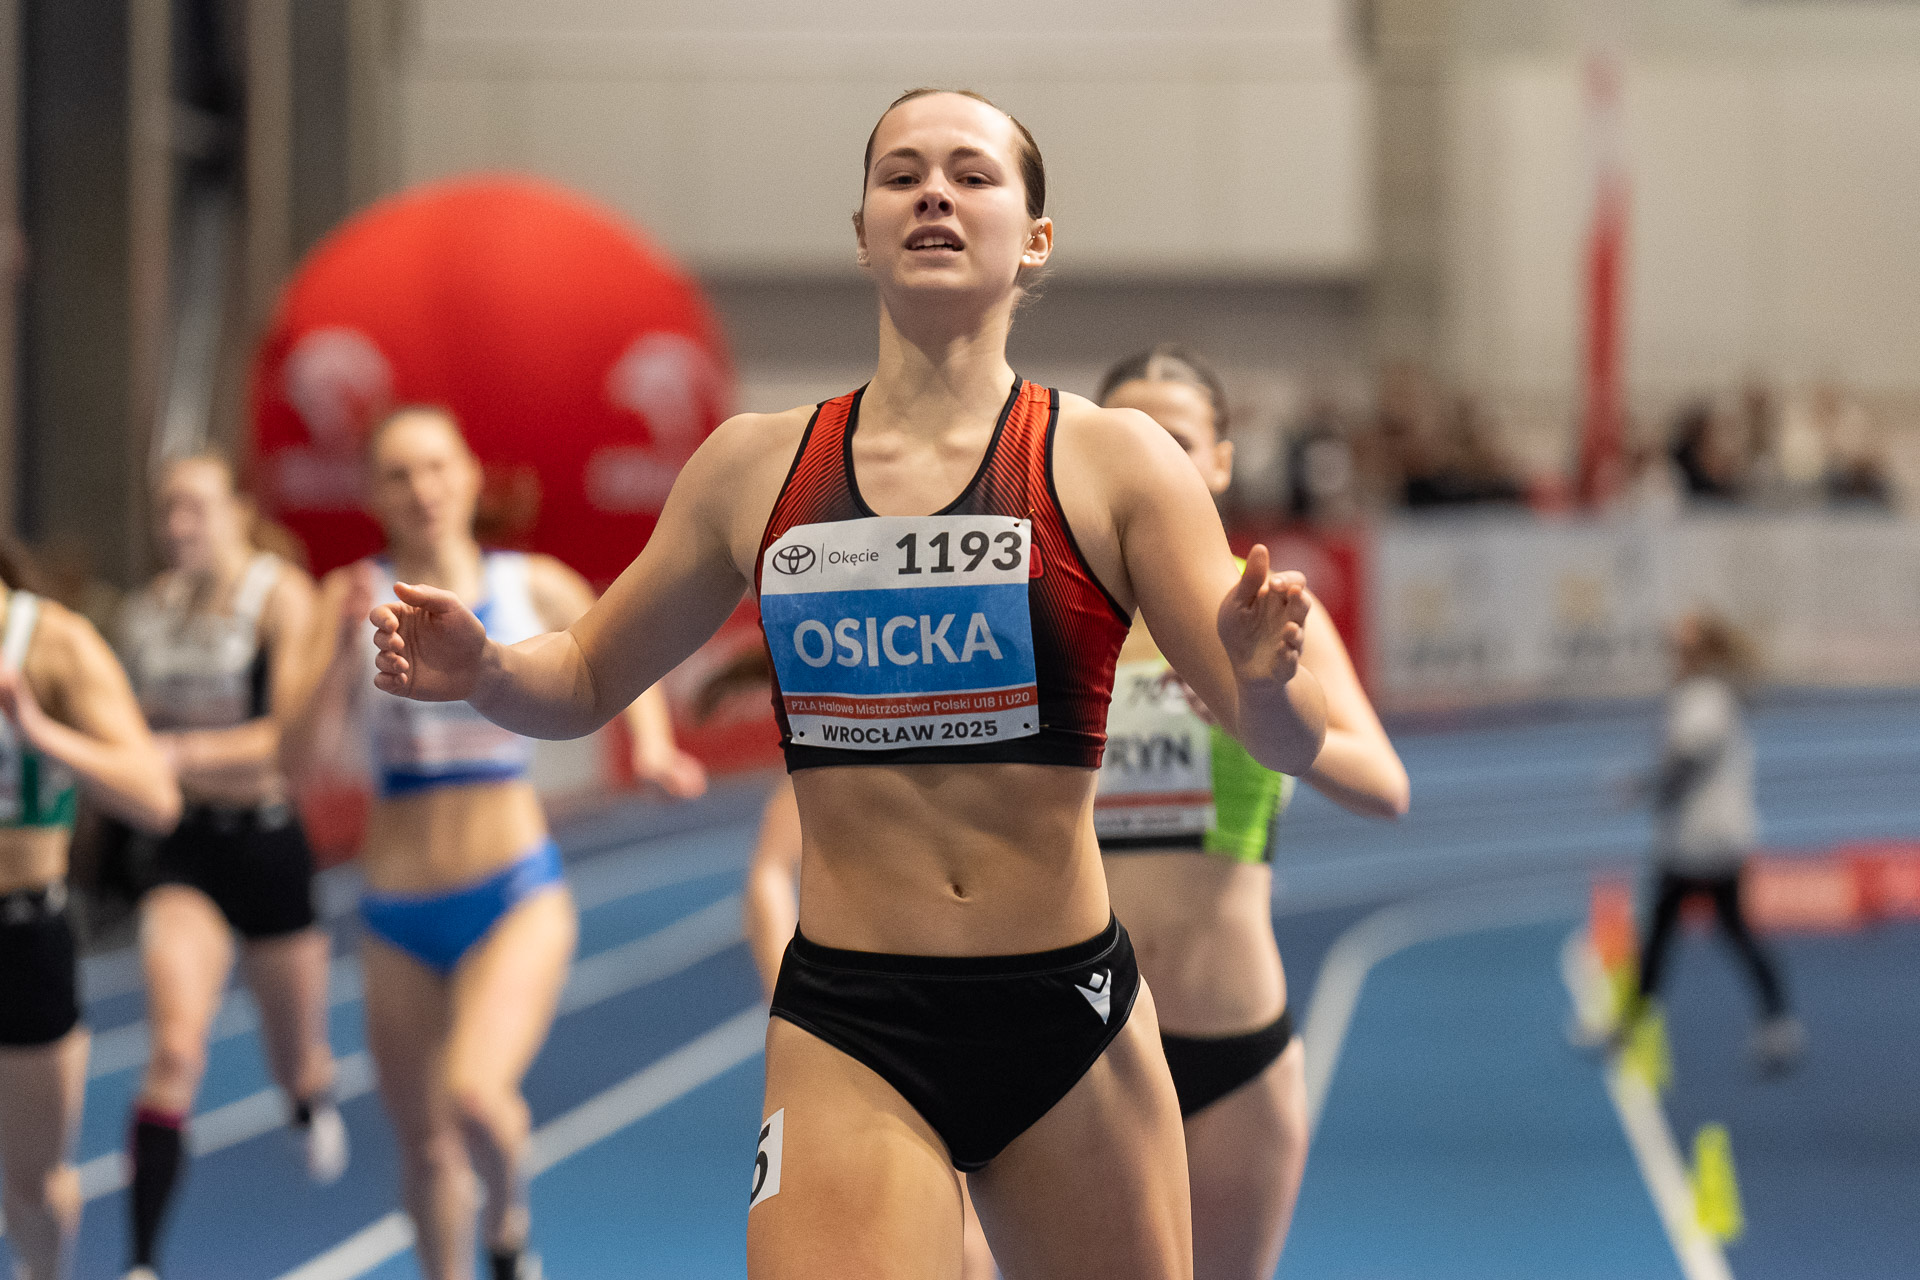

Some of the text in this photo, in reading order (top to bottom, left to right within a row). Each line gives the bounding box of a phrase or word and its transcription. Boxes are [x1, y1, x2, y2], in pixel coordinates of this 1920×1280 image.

[828, 549, 879, 567] Okęcie
[895, 531, 1022, 575] 1193
[793, 612, 1004, 668] OSICKA
[791, 700, 817, 711] PZLA
[818, 701, 854, 714] Halowe
[856, 702, 930, 715] Mistrzostwa
[933, 698, 971, 712] Polski
[973, 697, 996, 708] U18
[1005, 691, 1030, 705] U20
[822, 720, 998, 743] WROCŁAW 2025
